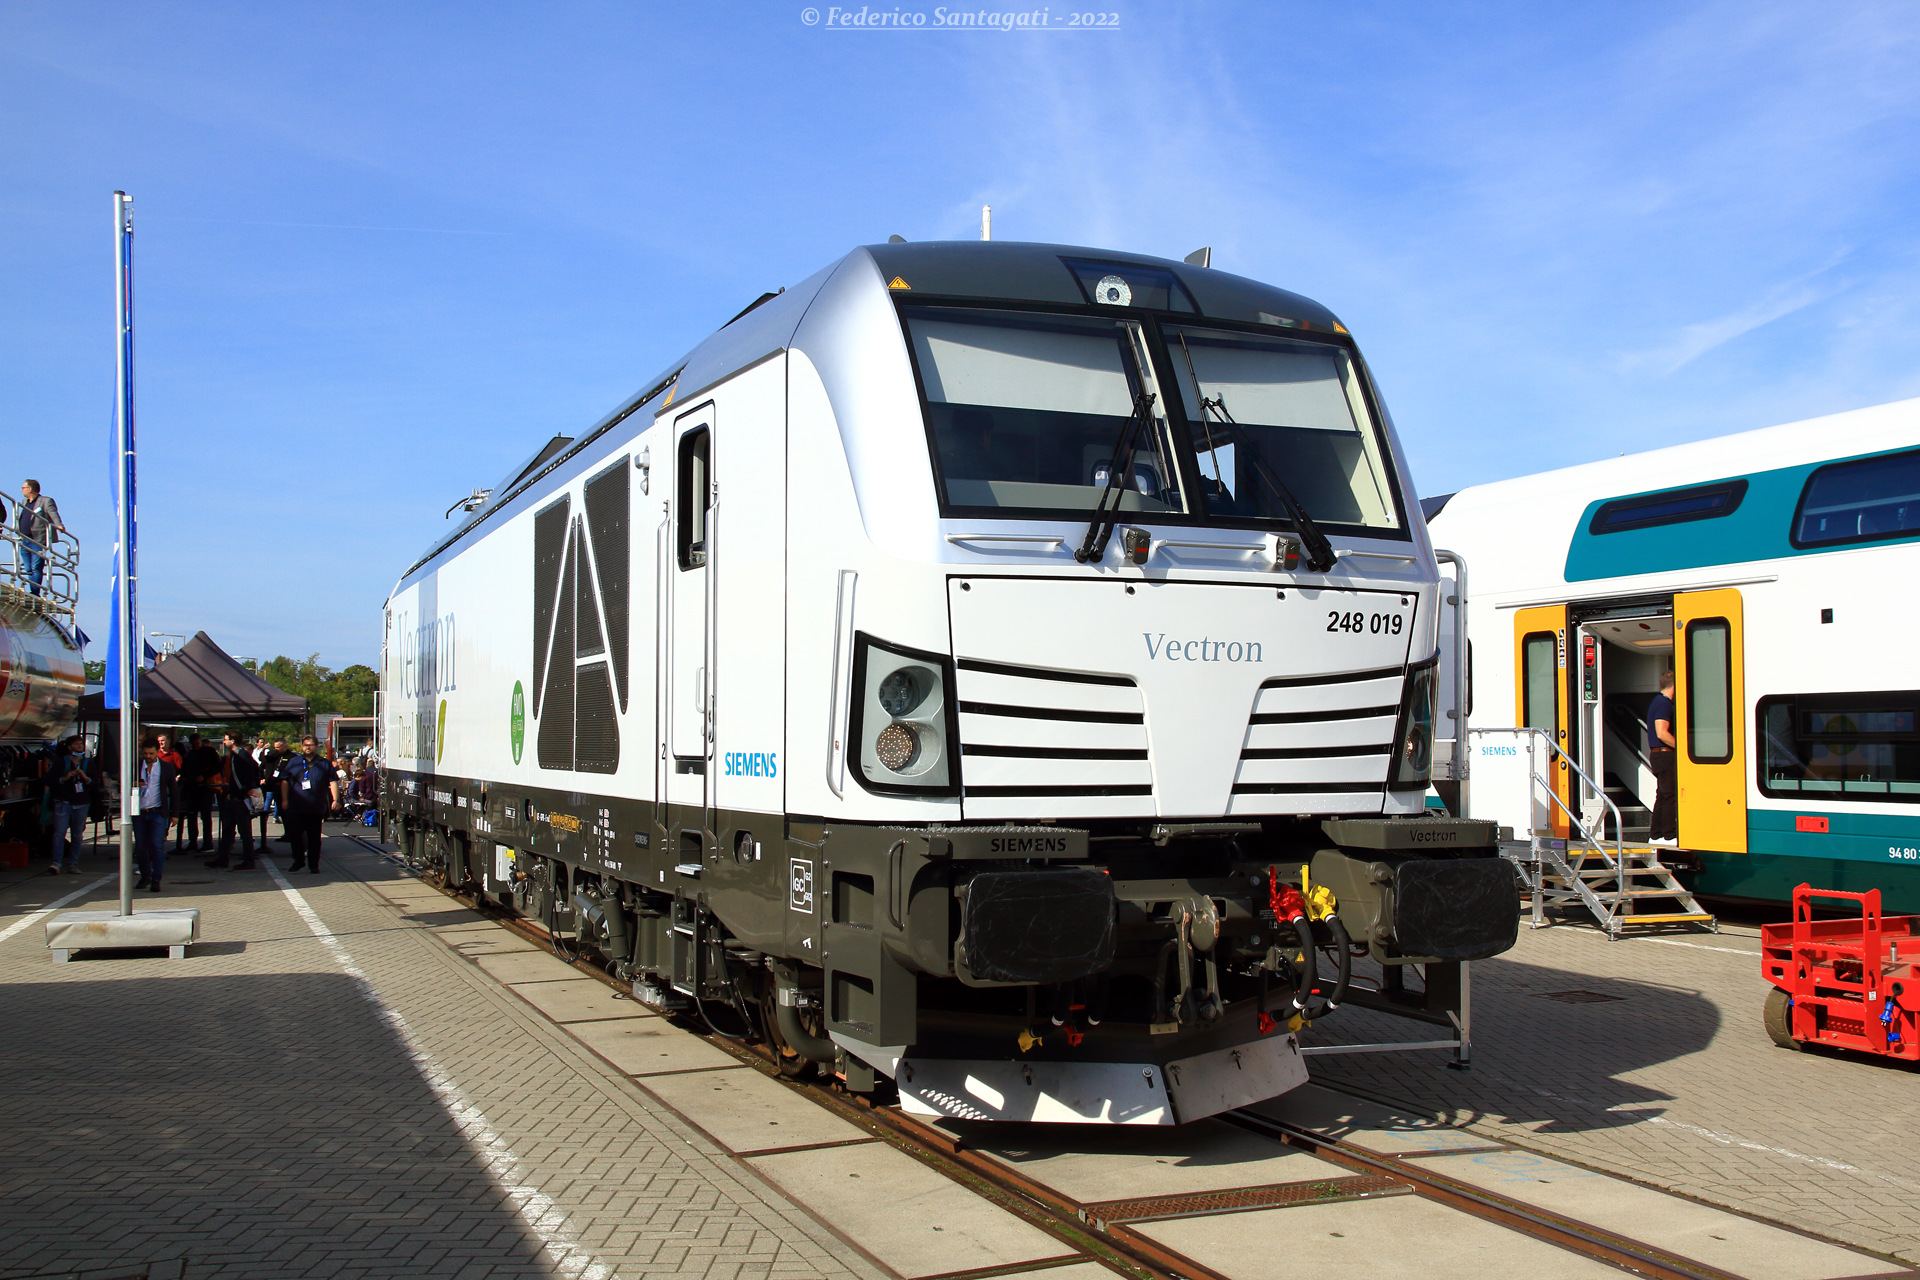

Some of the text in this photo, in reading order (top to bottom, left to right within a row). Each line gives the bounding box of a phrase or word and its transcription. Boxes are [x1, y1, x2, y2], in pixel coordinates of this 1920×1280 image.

[1326, 610, 1403, 636] 248 019
[398, 608, 457, 700] Vectron
[1142, 632, 1263, 663] Vectron
[398, 709, 436, 761] Dual Mode
[1481, 746, 1517, 756] SIEMENS
[724, 751, 777, 778] SIEMENS
[990, 837, 1066, 852] SIEMENS
[1409, 829, 1457, 842] Vectron
[1889, 846, 1902, 859] 94
[1903, 847, 1917, 860] 80
[794, 877, 805, 893] GC
